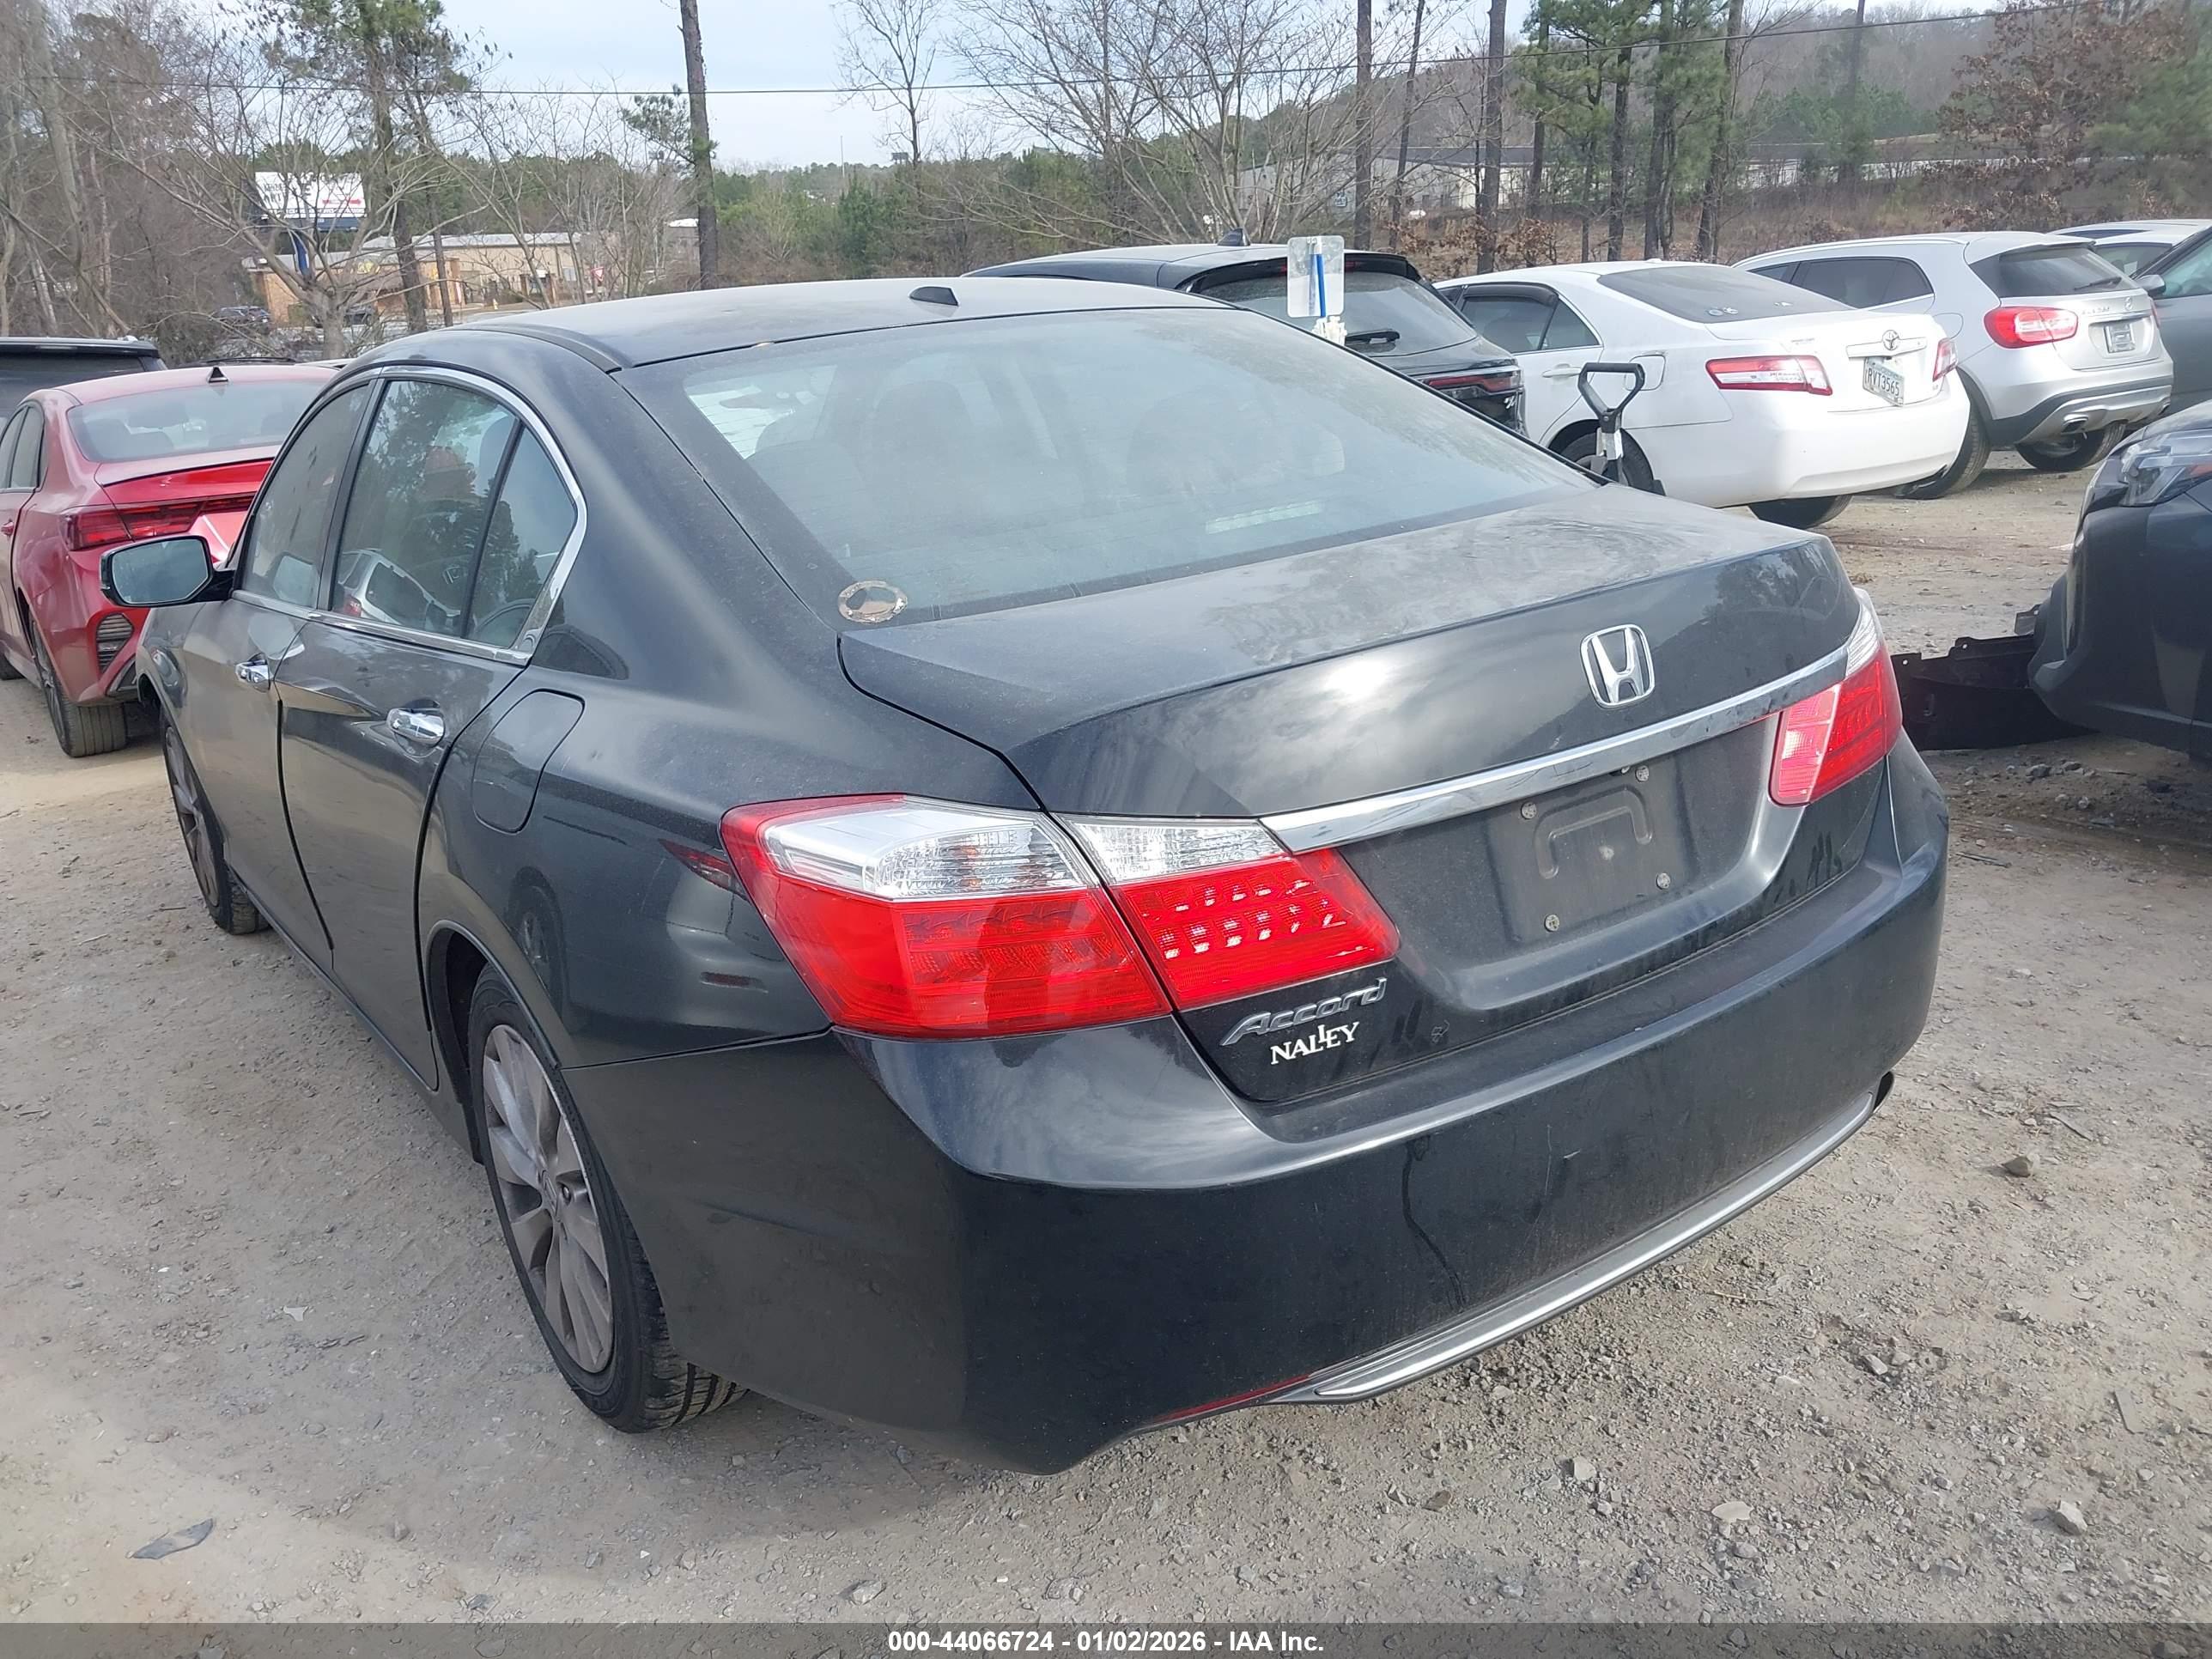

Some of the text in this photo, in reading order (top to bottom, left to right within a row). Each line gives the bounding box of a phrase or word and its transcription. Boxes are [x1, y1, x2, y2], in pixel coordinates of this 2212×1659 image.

[1868, 368, 1899, 396] RVT3565
[1219, 977, 1388, 1046] Accord
[1270, 1021, 1360, 1065] NALLEY
